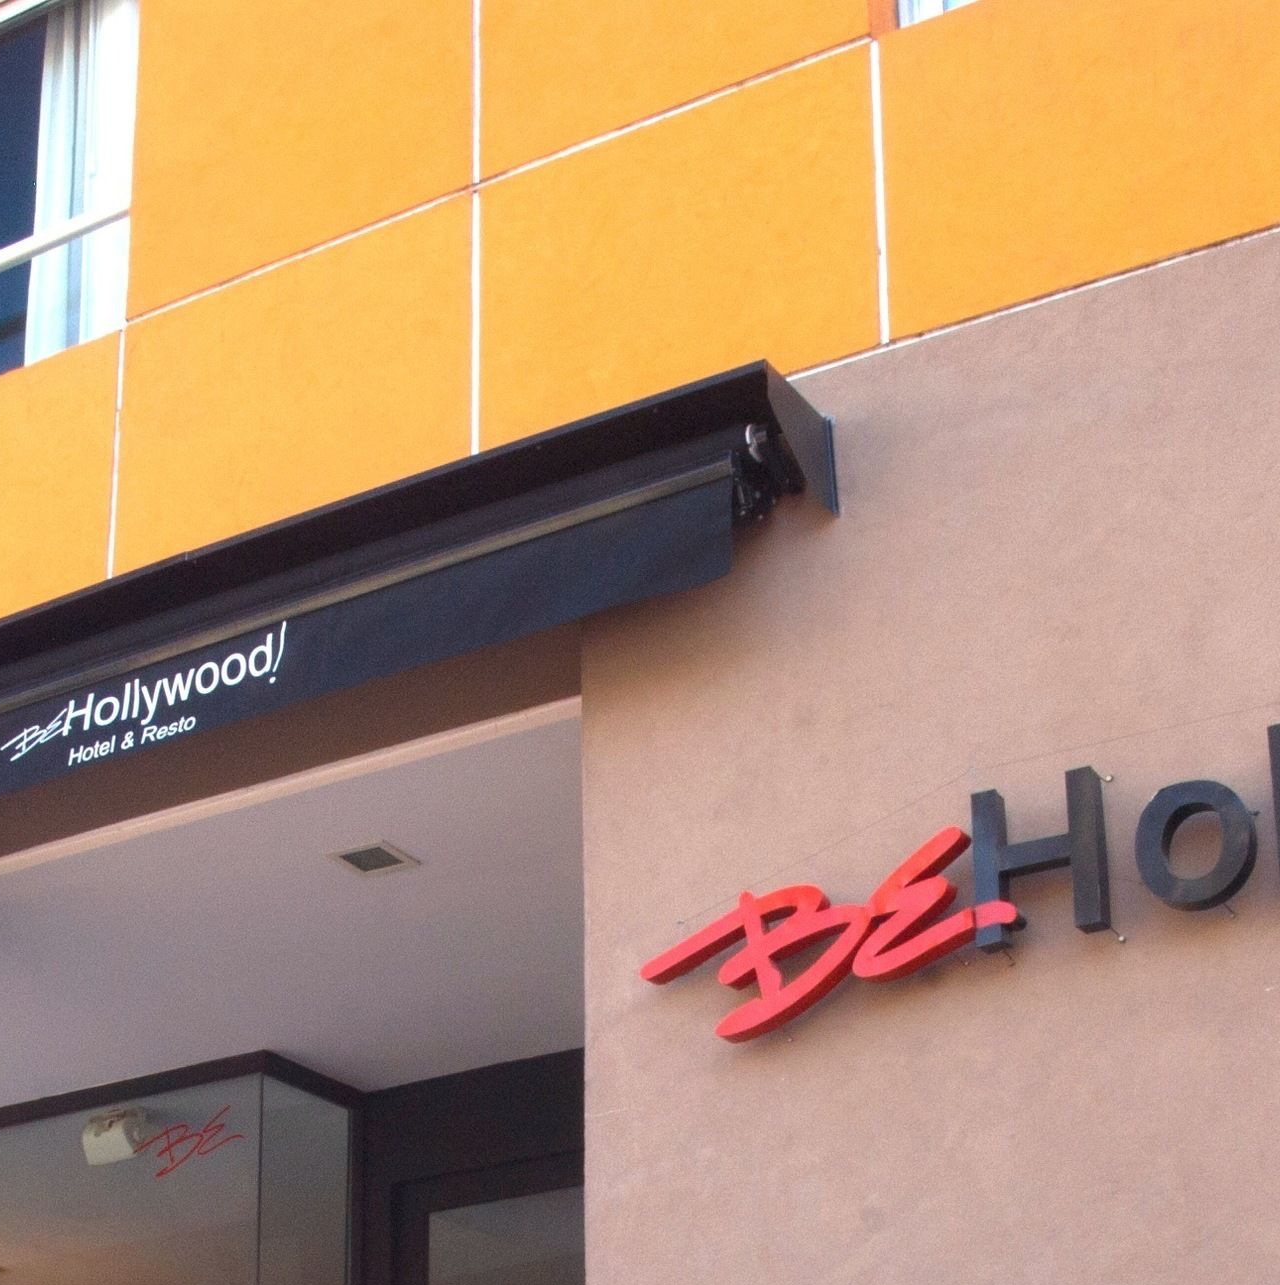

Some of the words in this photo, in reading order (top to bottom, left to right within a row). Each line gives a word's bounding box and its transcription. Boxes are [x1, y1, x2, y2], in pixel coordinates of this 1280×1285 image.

[68, 735, 116, 766] Hotel
[120, 731, 135, 750] &
[140, 715, 197, 745] Resto
